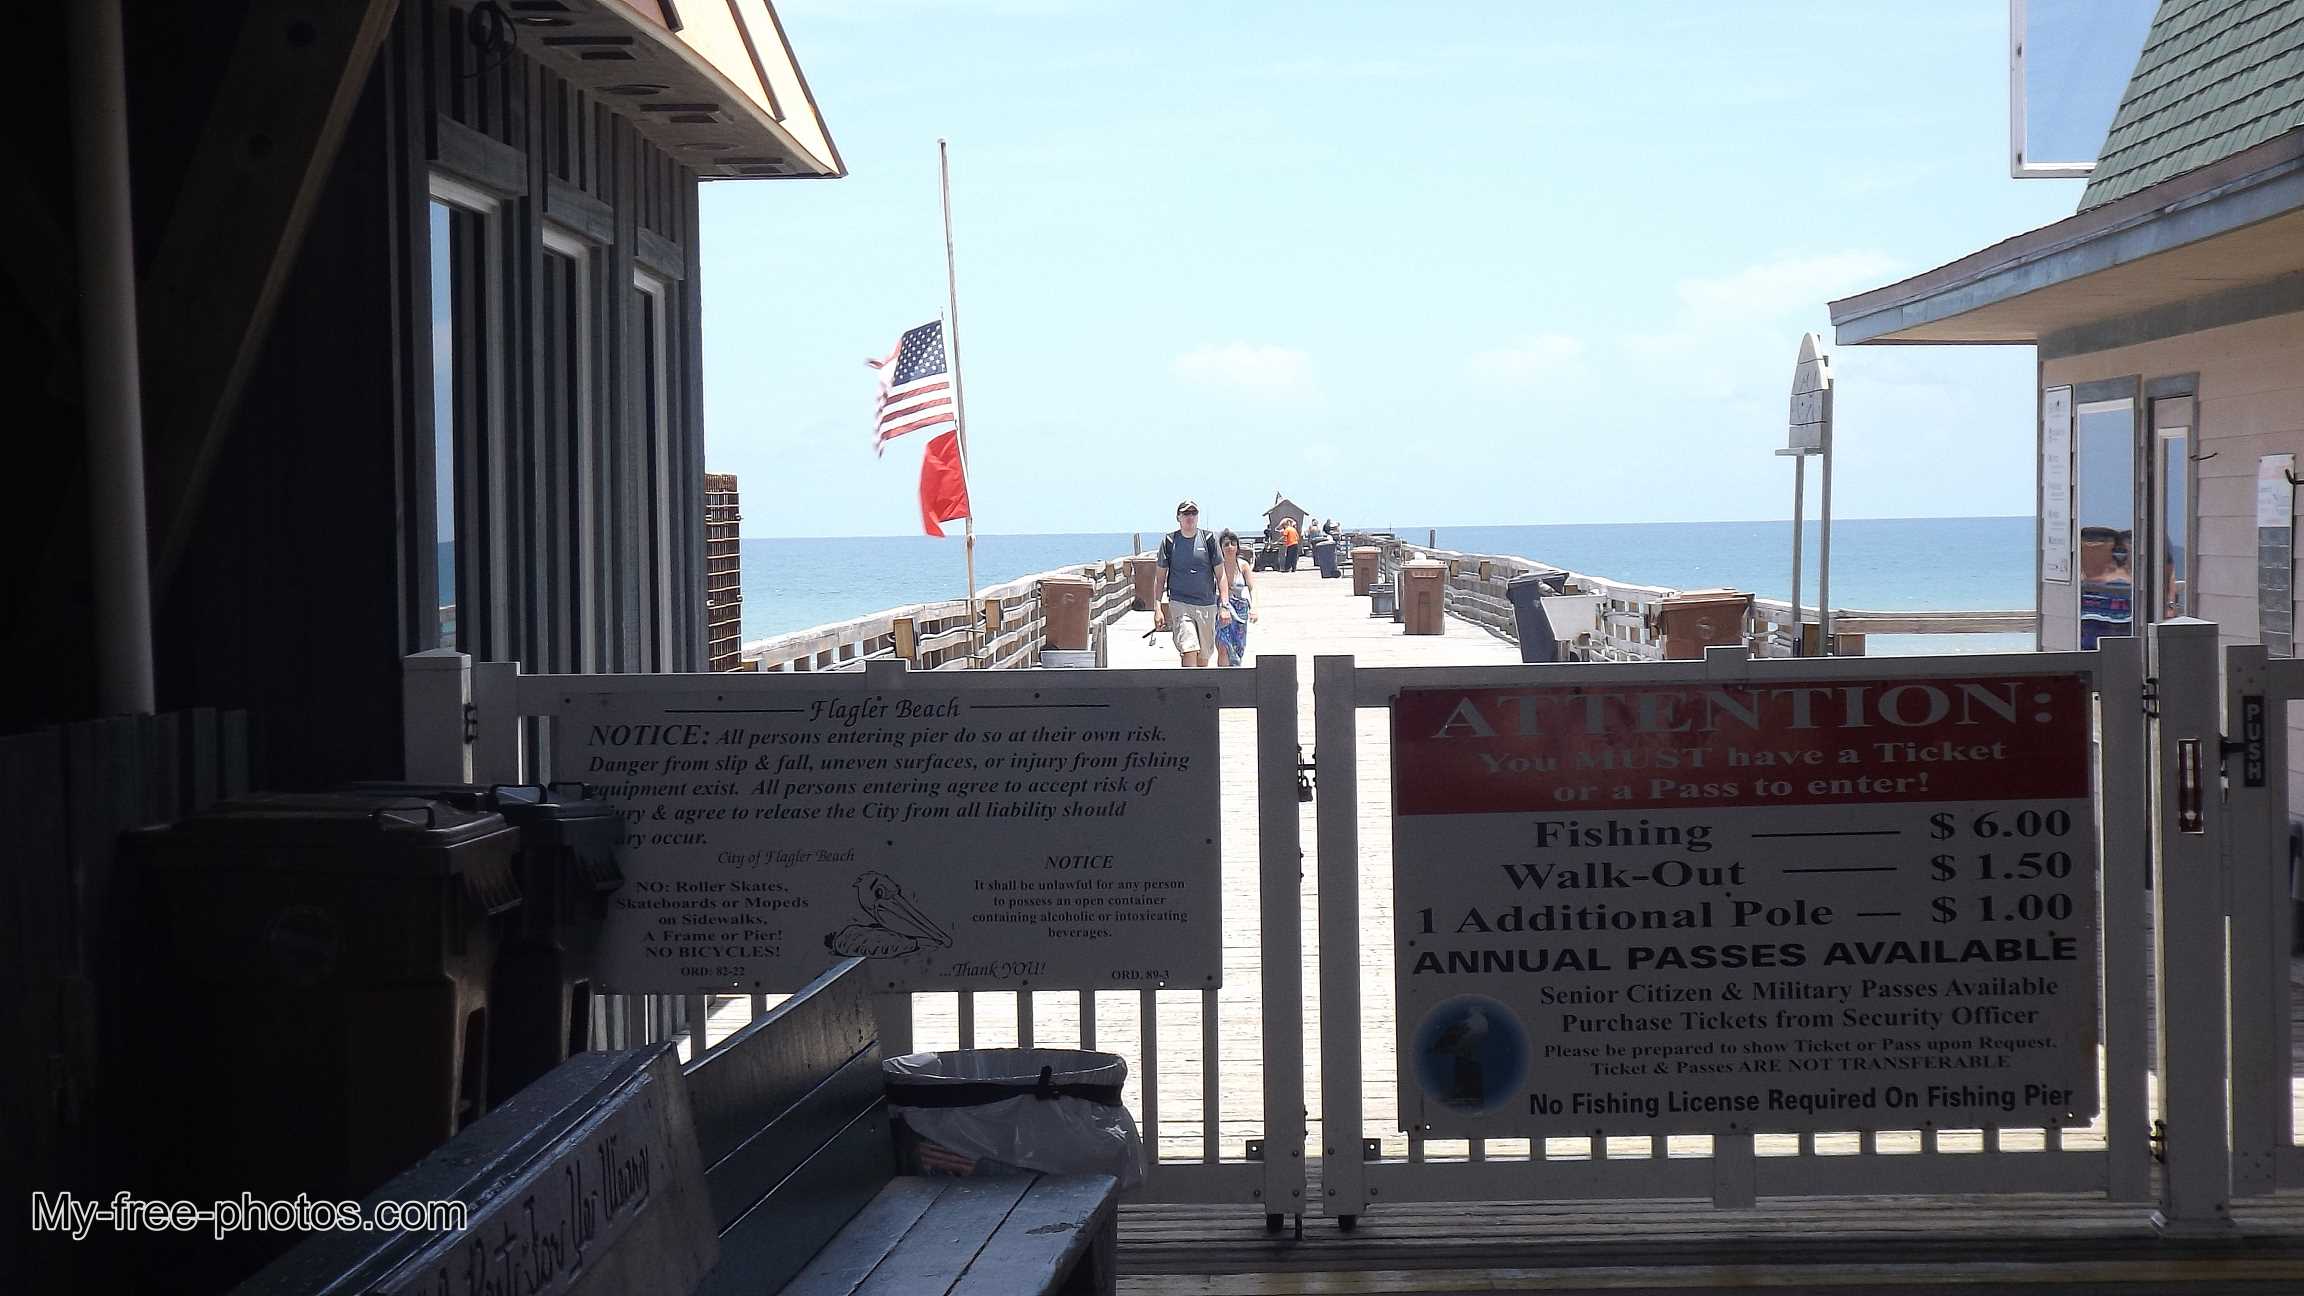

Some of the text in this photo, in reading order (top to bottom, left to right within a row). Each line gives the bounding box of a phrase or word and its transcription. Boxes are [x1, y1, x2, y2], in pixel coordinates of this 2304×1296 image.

[808, 697, 961, 727] Flagler Beach
[1430, 682, 2052, 739] ATTENTION:
[587, 724, 1167, 749] NOTICE: All persons entering pier do so at their own risk.
[2246, 703, 2262, 780] PUSH
[588, 751, 1191, 776] Danger from slip & fall, uneven surfaces, or injury from fishing
[1476, 741, 2006, 774] You MUST have a Ticket
[692, 780, 739, 797] exist.
[751, 778, 780, 796] All
[784, 780, 857, 800] persons
[863, 780, 940, 797] entering
[946, 781, 999, 797] agree
[1004, 779, 1022, 794] to
[1028, 779, 1088, 796] accept
[1093, 776, 1127, 793] risk
[1133, 776, 1157, 796] of
[1553, 771, 1930, 801] or a Pass to enter!
[650, 803, 668, 821] &
[674, 807, 727, 824] agree
[731, 804, 749, 821] to
[754, 803, 821, 821] release
[826, 802, 856, 819] the
[862, 801, 900, 822] City
[901, 801, 950, 822] from
[955, 801, 982, 818] all
[985, 800, 1057, 822] liability
[1062, 800, 1128, 818] should
[650, 831, 708, 846] occur.
[1535, 809, 2072, 853] Fishing $ 6.00
[718, 847, 855, 869] City of Flagler Beach
[1044, 855, 1115, 869] NOTICE
[1501, 851, 2072, 891] Walk-Out $ 1.50
[635, 880, 671, 894] NO:
[675, 880, 728, 893] Roller
[974, 878, 1185, 893] It shall be unlawful for any person
[614, 896, 810, 911] Skateboards or Mopeds
[993, 895, 1167, 909] to possess an open container
[1416, 893, 2073, 935] 1 Additional Pole $ 1.00
[658, 915, 677, 926] on
[971, 910, 1189, 925] containing alcoholic or intoxicating
[642, 929, 783, 942] A Frame or Pier!
[1048, 927, 1113, 940] beverages.
[645, 945, 781, 959] NO BICYCLES!
[1412, 937, 2079, 975] ANNUAL PASSES AVAILABLE
[1540, 977, 2059, 1005] Senior Citizen & Military Passes Available
[1561, 1006, 2040, 1033] Purchase Tickets from Security Officer
[1544, 1036, 2057, 1059] Please be prepared to show Ticket or Pass upon Request.
[1590, 1055, 2011, 1076] Ticket & Passes ARE NOT TRANSFERABLE
[1529, 1083, 2074, 1119] No Fishing License Required On Fishing Pier
